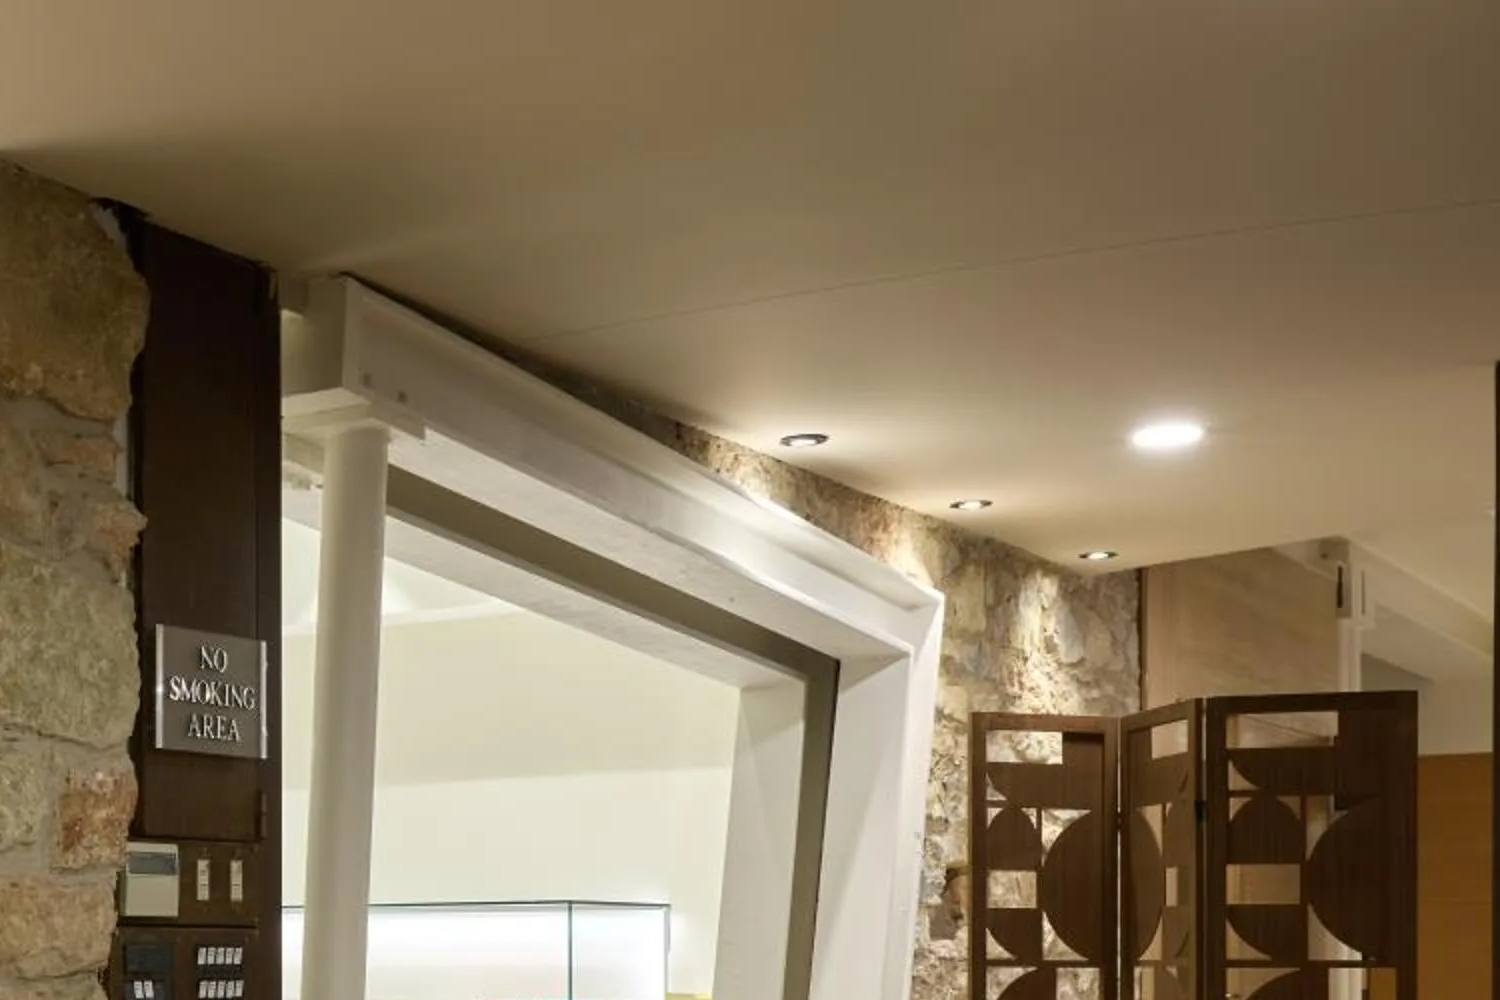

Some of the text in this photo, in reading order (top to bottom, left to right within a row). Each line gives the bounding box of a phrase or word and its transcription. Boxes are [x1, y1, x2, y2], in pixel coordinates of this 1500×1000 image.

[199, 645, 228, 673] NO
[169, 675, 256, 710] SMOKING
[188, 713, 242, 742] AREA
